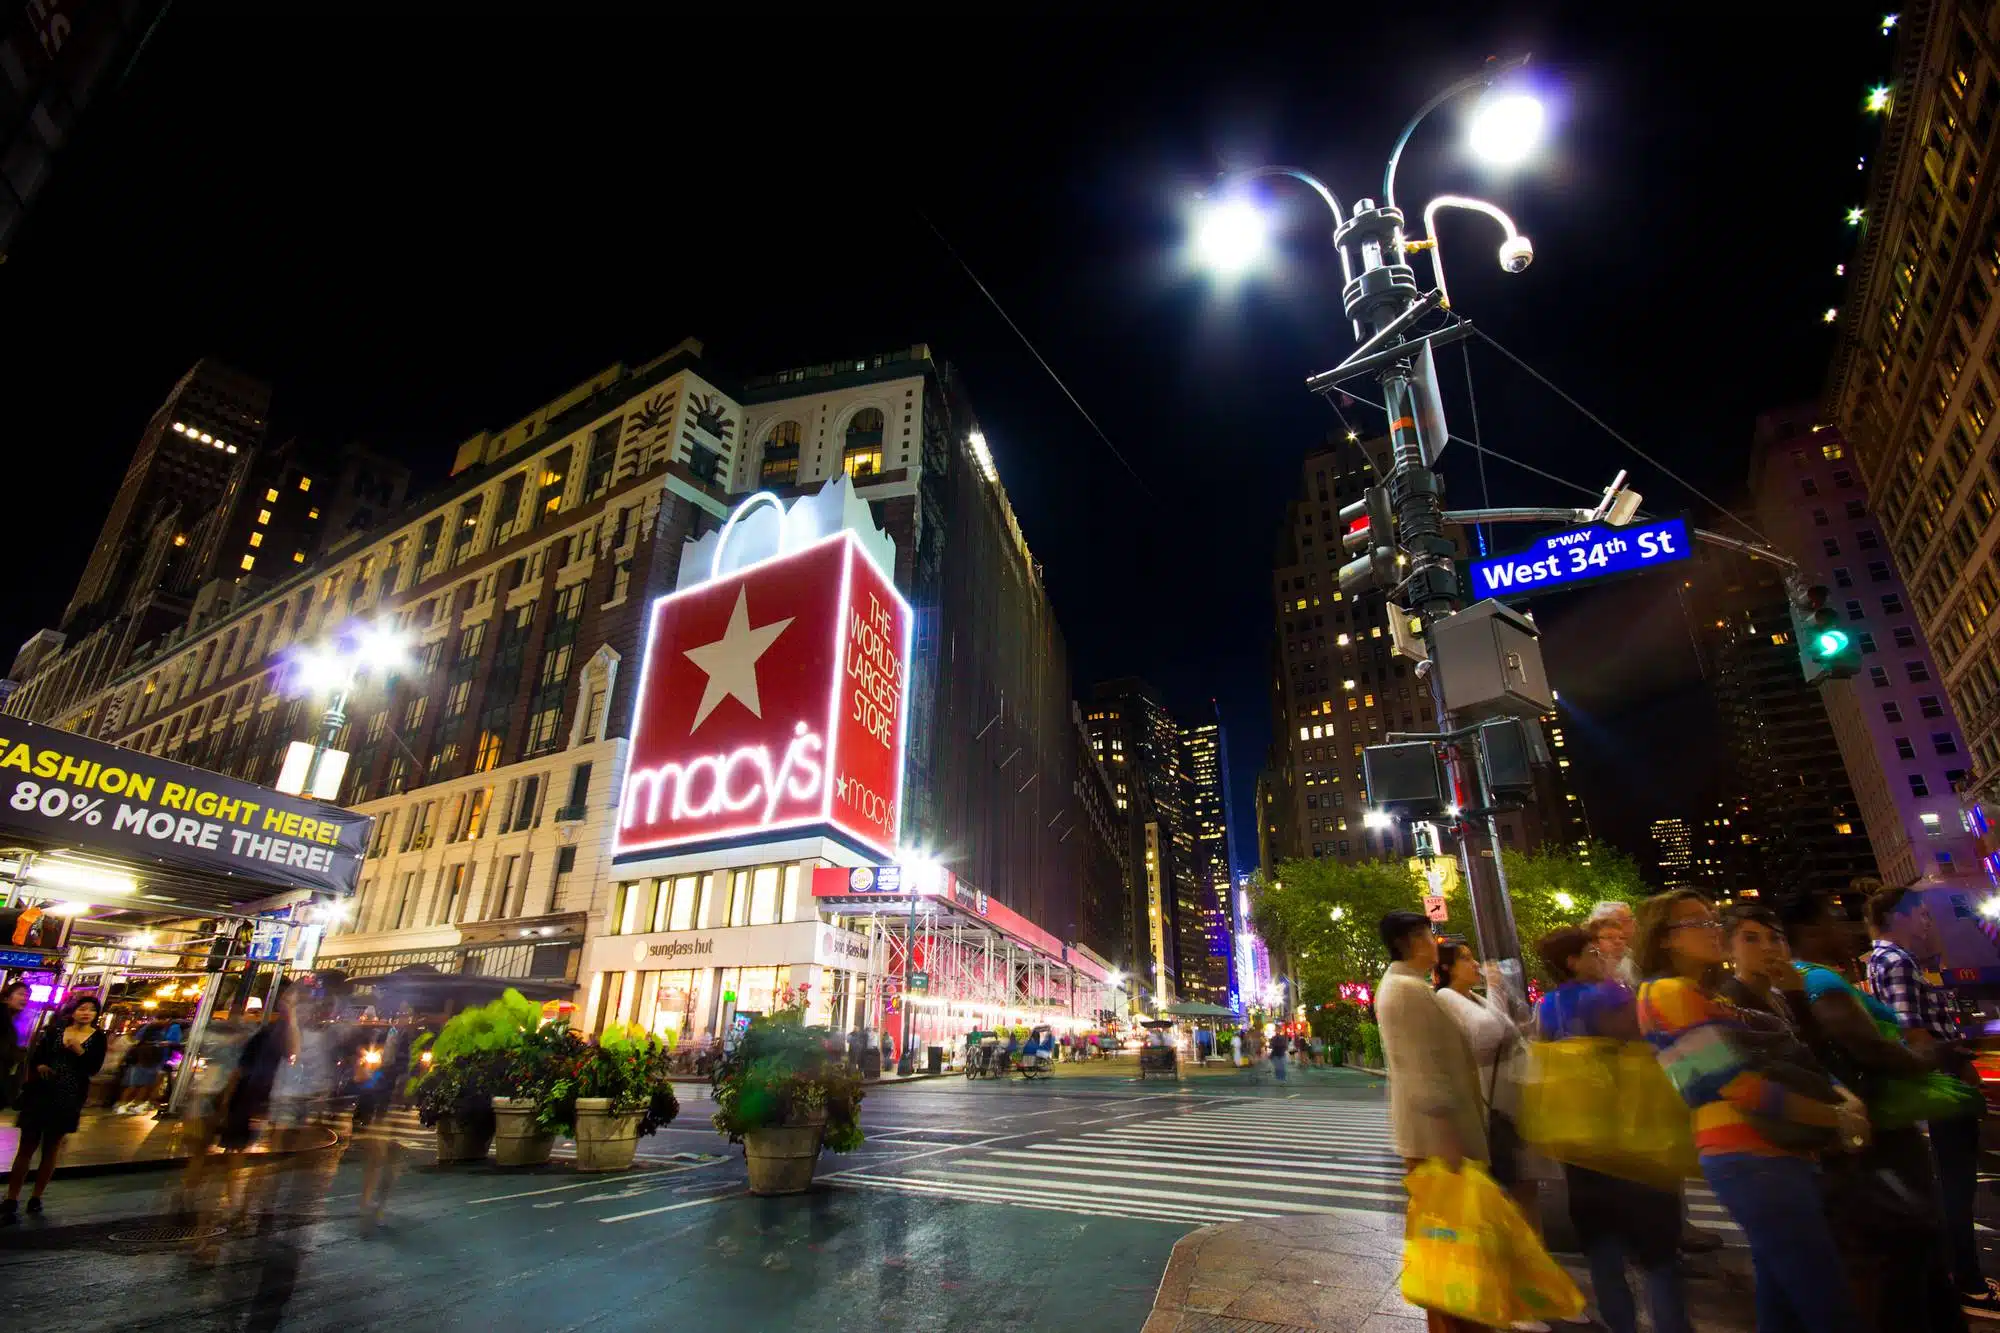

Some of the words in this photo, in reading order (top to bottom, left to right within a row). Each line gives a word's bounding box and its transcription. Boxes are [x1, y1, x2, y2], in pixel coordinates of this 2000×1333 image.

[1482, 554, 1562, 590] West
[1567, 537, 1628, 573] 34th
[1637, 530, 1676, 559] St
[1547, 530, 1592, 549] B'WAY
[850, 606, 903, 689] WORLD'S
[869, 592, 892, 643] THE
[847, 642, 900, 720] LARGEST
[853, 689, 892, 750] STORE
[10, 781, 106, 826] 80%
[112, 803, 224, 851] MORE
[230, 829, 335, 873] THERE!
[159, 782, 260, 826] RIGHT
[261, 807, 342, 846] HERE!
[649, 940, 693, 959] sunglass
[694, 938, 713, 954] hut
